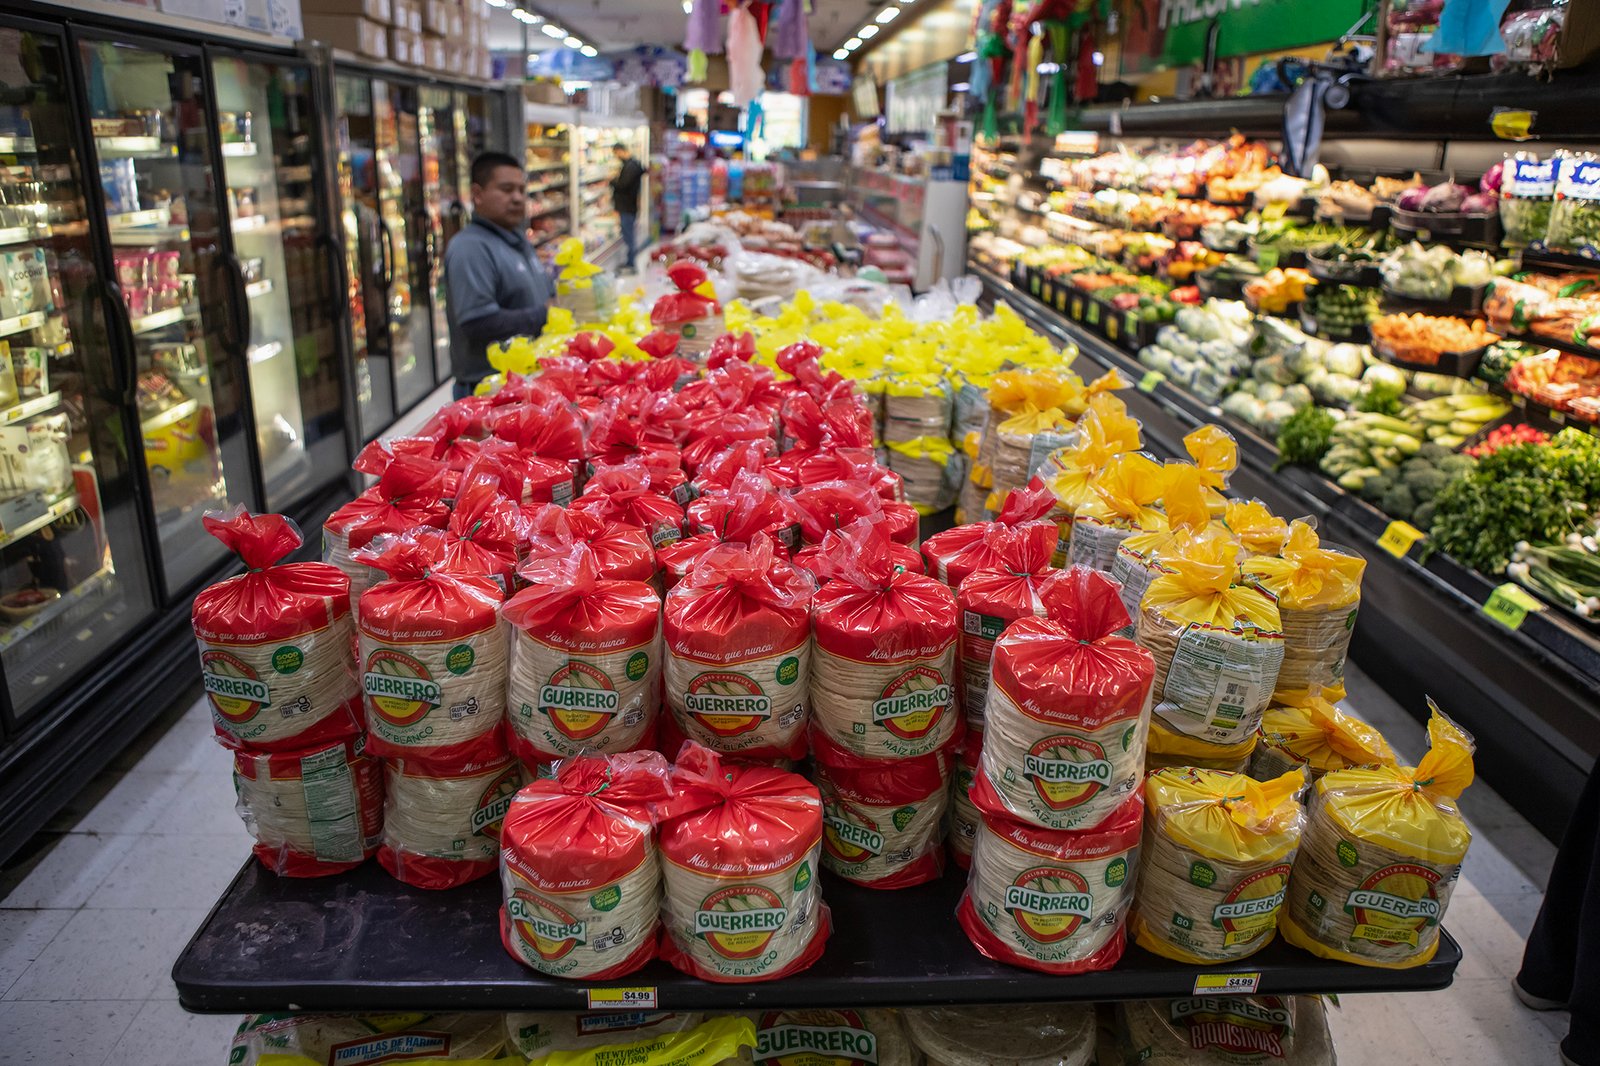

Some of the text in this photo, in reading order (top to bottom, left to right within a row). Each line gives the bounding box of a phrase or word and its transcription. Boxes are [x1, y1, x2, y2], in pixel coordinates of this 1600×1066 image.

[412, 630, 444, 638] nunca
[600, 637, 628, 648] nunca
[676, 641, 774, 662] Más suaves que nunca
[866, 649, 888, 660] Más
[920, 645, 937, 656] que
[364, 676, 437, 698] GUERRERO
[686, 696, 768, 712] GUERRERO
[876, 688, 948, 716] GUERRERO
[1022, 699, 1041, 714] Más
[1044, 710, 1080, 720] suaves
[854, 724, 864, 734] 80
[724, 736, 764, 750] BLANCO
[910, 738, 939, 756] BLAN
[1039, 738, 1064, 750] CALIDAD
[1026, 757, 1109, 780] GUERRERO
[474, 799, 510, 826] GUER
[834, 821, 881, 850] RRERO
[1010, 828, 1028, 844] Más
[1030, 840, 1063, 854] suaves
[1065, 846, 1082, 858] que
[502, 847, 592, 888] Más suaves que nunca
[687, 853, 710, 870] Más
[768, 852, 794, 872] nunca
[1108, 864, 1124, 874] GOOD
[1194, 864, 1214, 876] GOOD
[1024, 870, 1048, 880] CALIDAD
[1236, 872, 1266, 892] CALIDAD
[1376, 867, 1410, 880] CALIDAD
[710, 890, 734, 902] CALIDAD
[742, 888, 772, 900] FRESCURA
[1008, 888, 1090, 912] GUERRERO
[1312, 894, 1322, 906] 80
[698, 912, 786, 930] GUERRERO
[1176, 917, 1190, 928] 80
[595, 936, 613, 944] GLUTEN
[1036, 941, 1078, 960] BLAN
[734, 950, 778, 975] BLANCO
[624, 991, 650, 1000] $4.99
[1176, 999, 1288, 1023] GUERRERO
[336, 1036, 444, 1060] TORTILLAS DE HARINA
[755, 1029, 872, 1056] GUERRERO
[1140, 1050, 1150, 1060] 24
